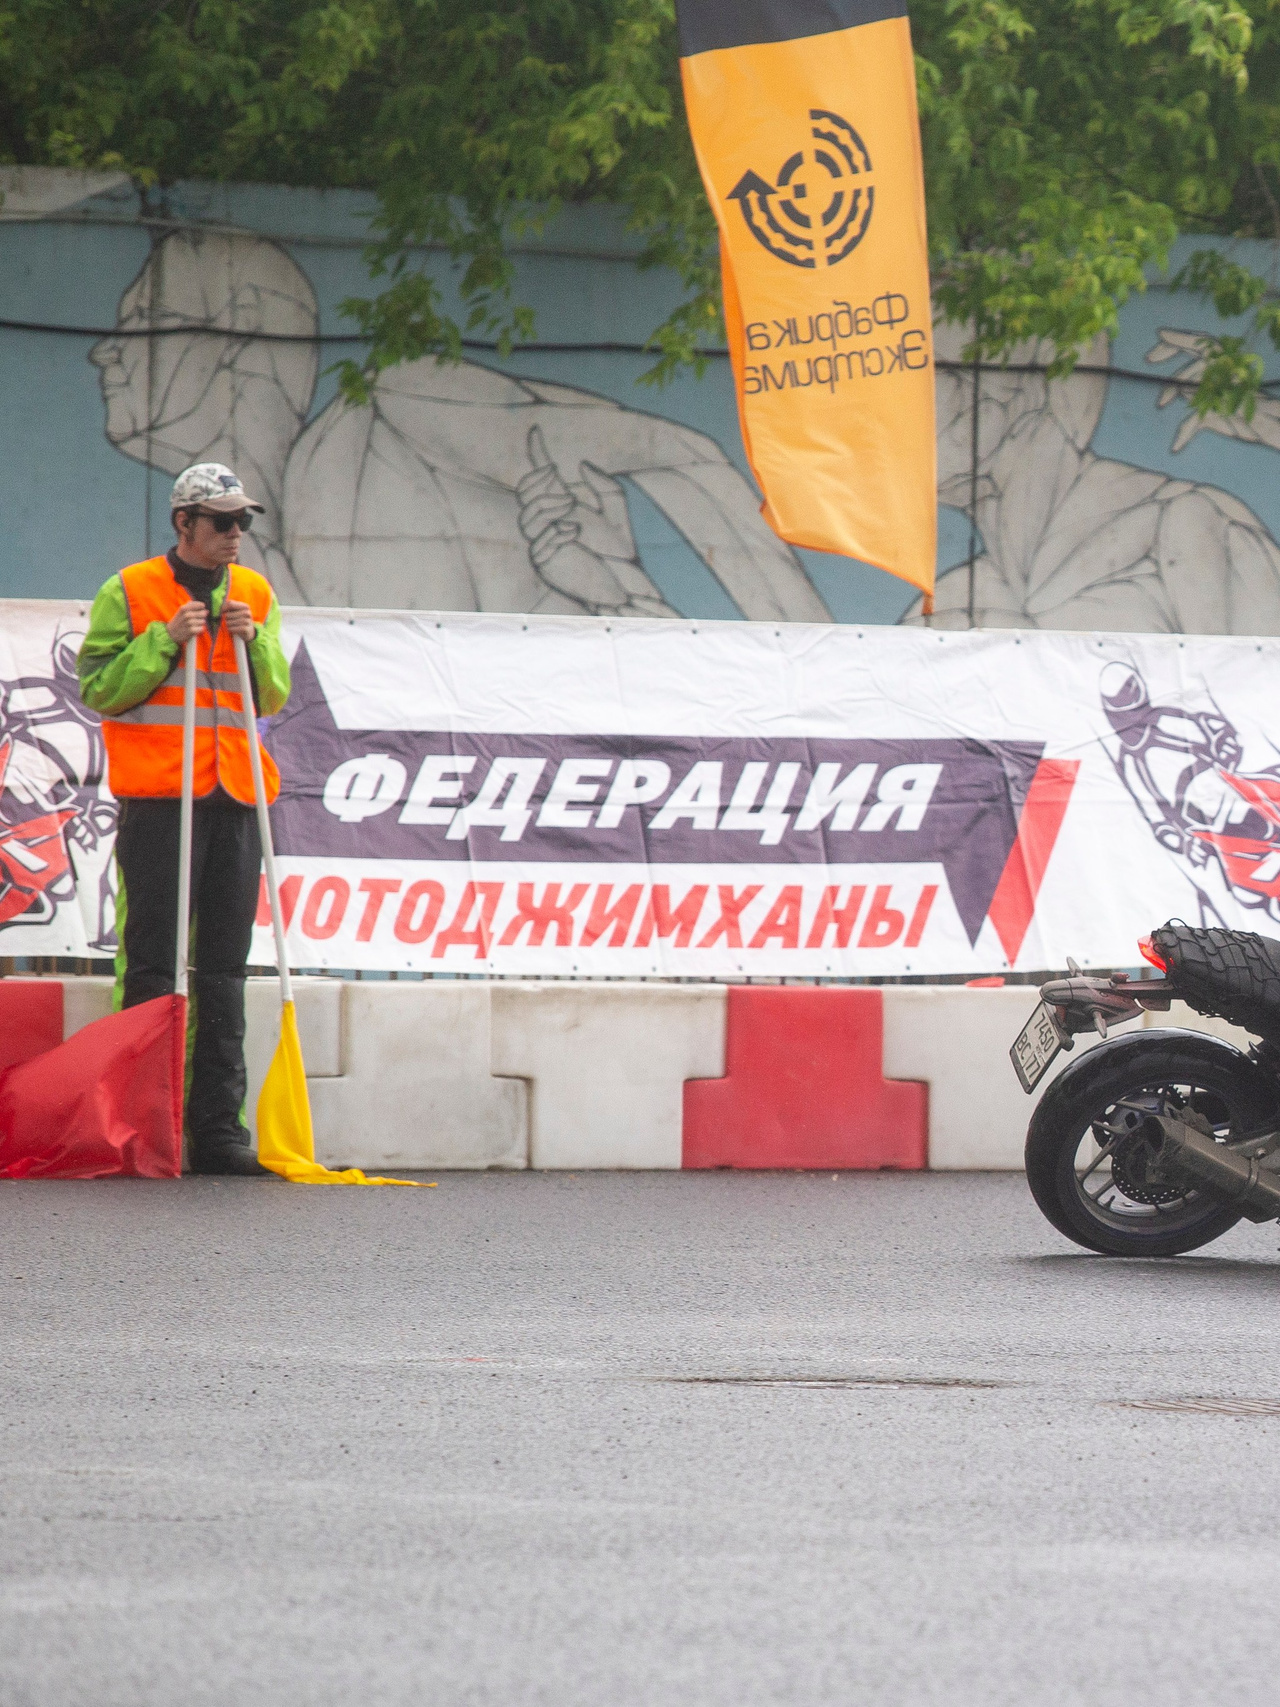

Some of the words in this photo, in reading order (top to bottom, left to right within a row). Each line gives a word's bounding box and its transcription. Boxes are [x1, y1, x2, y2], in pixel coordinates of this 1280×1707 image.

[322, 753, 944, 845] ФЕДЕРАЦИЯ
[1033, 1012, 1055, 1053] 7450
[1025, 1053, 1041, 1078] 77
